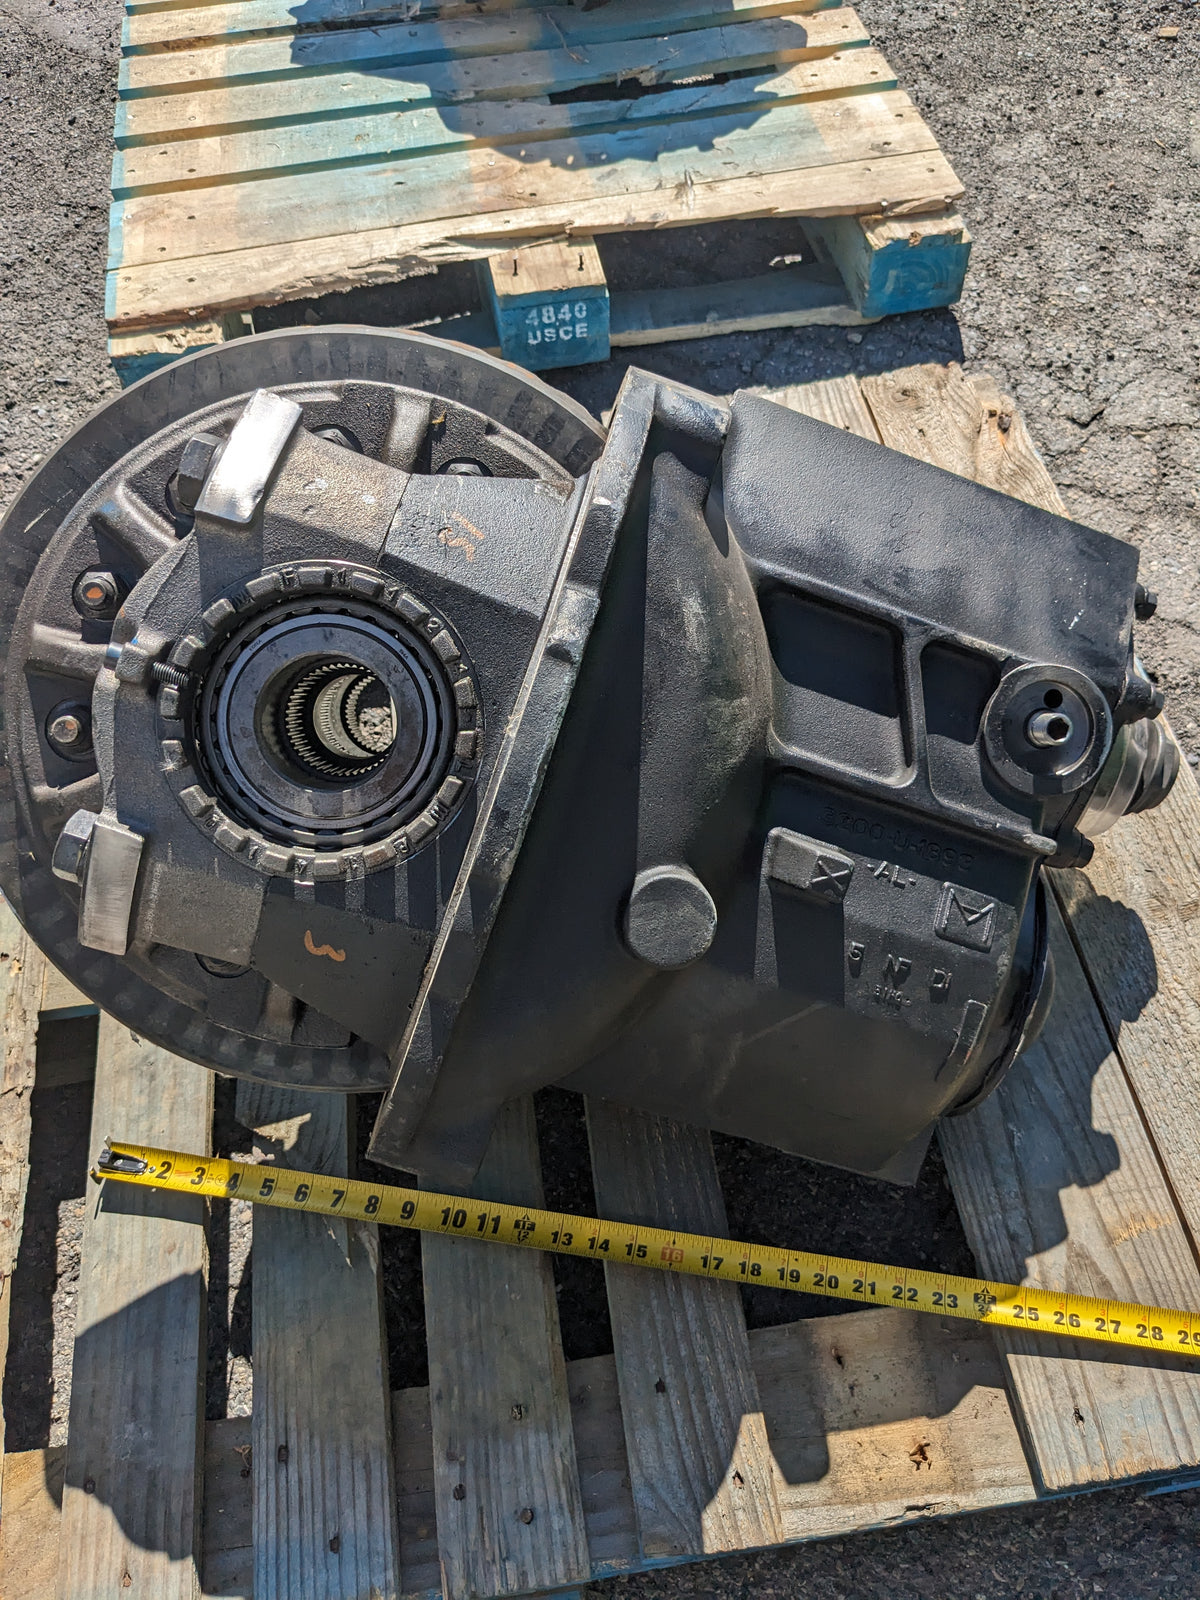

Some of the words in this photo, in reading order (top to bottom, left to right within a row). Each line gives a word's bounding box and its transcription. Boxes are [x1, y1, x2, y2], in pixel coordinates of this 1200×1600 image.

[527, 323, 588, 345] USCE
[155, 1161, 172, 1180] 2
[191, 1166, 206, 1185] 3
[226, 1172, 241, 1191] 4
[259, 1178, 275, 1197] 5
[294, 1184, 310, 1202] 6
[330, 1190, 345, 1208] 7
[364, 1195, 380, 1214] 8
[400, 1201, 416, 1220] 9
[441, 1207, 467, 1229] 10
[477, 1213, 501, 1234] 11
[551, 1230, 573, 1246] 13
[588, 1237, 610, 1252] 14
[625, 1243, 648, 1258] 15
[663, 1247, 683, 1262] 16
[701, 1254, 724, 1271] 17
[739, 1260, 762, 1277] 18
[777, 1266, 800, 1283] 19
[813, 1272, 839, 1289] 20
[853, 1279, 876, 1295] 21
[892, 1285, 918, 1302] 22
[932, 1291, 958, 1309] 23
[1013, 1304, 1039, 1321] 25
[1053, 1310, 1080, 1328] 26
[1094, 1317, 1121, 1334] 27
[1136, 1323, 1164, 1341] 28
[1177, 1329, 1200, 1347] 29
